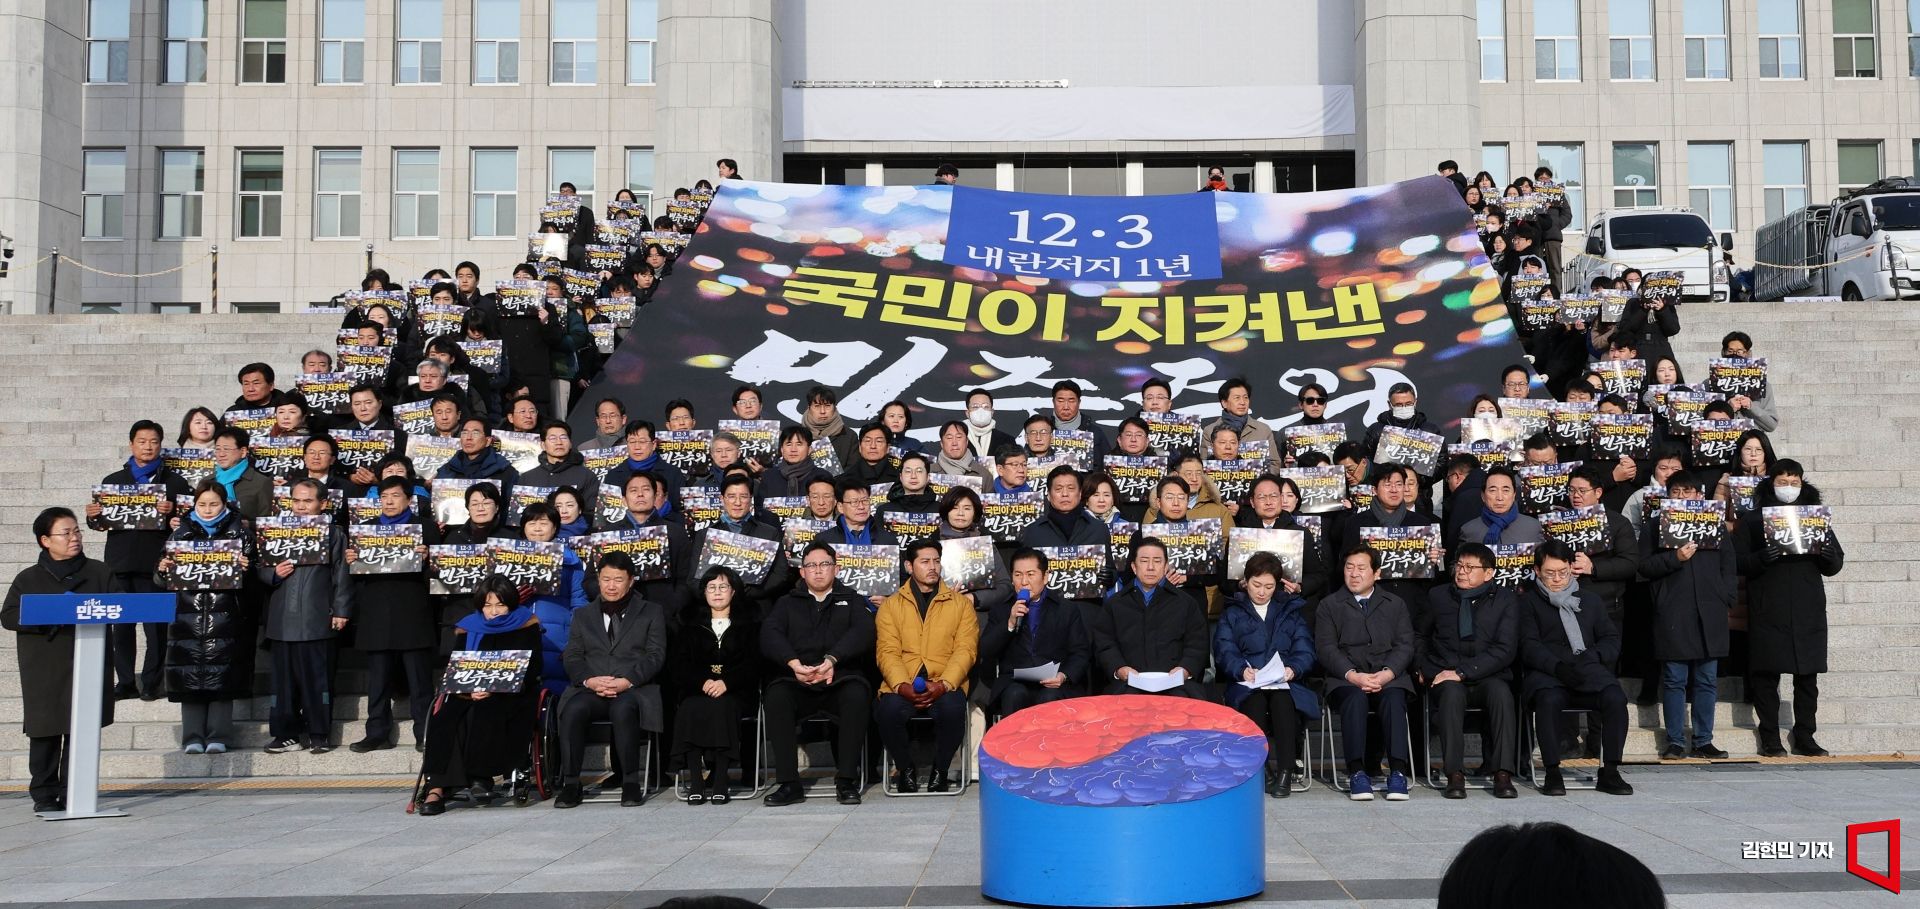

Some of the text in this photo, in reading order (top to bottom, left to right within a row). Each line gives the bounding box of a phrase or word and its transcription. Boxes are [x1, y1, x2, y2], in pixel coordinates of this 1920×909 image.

[1009, 209, 1153, 249] 12·3
[966, 245, 1193, 279] 내란저지 1년
[782, 265, 1385, 345] 국민이 지켜낸
[1717, 369, 1739, 377] 국민이
[1717, 378, 1760, 392] 민주주의
[305, 393, 350, 408] 민주주의
[1149, 424, 1170, 432] 국민이
[1601, 426, 1623, 434] 국민이
[338, 441, 360, 449] 국민이
[1295, 437, 1317, 446] 국민이
[1600, 435, 1646, 452] 민주주의
[659, 443, 681, 451] 국민이
[1386, 444, 1430, 464] 민주주의
[255, 458, 304, 475] 민주주의
[1113, 468, 1159, 477] 국민이 지켜낸
[1208, 472, 1230, 480] 국민이
[1531, 477, 1553, 486] 국민이
[102, 496, 156, 504] 국민이 지켜낸
[102, 505, 157, 522] 민주주의
[694, 510, 719, 519] 국민이
[985, 506, 1008, 514] 국민이
[1671, 514, 1718, 522] 국민이 지켜낸
[985, 516, 1036, 534] 민주주의
[1573, 519, 1597, 530] 지켜낸
[1802, 519, 1824, 527] 지켜낸
[266, 528, 318, 537] 국민이 지켜낸
[1669, 523, 1718, 541] 민주주의
[359, 537, 413, 546] 국민이 지켜낸
[1181, 536, 1205, 545] 지켜낸
[1371, 540, 1424, 549] 국민이 지켜낸
[265, 541, 320, 558] 민주주의
[604, 540, 658, 554] 국민이 지켜낸
[359, 547, 413, 565] 민주주의
[714, 544, 741, 555] 국민이
[742, 548, 768, 560] 지켜낸
[1168, 547, 1206, 566] 주주의
[177, 553, 232, 561] 국민이 지켜낸
[497, 552, 552, 565] 국민이 지켜낸
[1510, 556, 1534, 565] 지켜낸
[439, 558, 465, 566] 국민이
[836, 558, 889, 567] 국민이 지켜낸
[1070, 559, 1096, 568] 지켜낸
[176, 563, 233, 582] 민주주의
[837, 569, 890, 587] 민주주의
[77, 605, 122, 619] 민주당
[459, 661, 517, 669] 국민이 지켜낸
[453, 670, 514, 686] 민주주의
